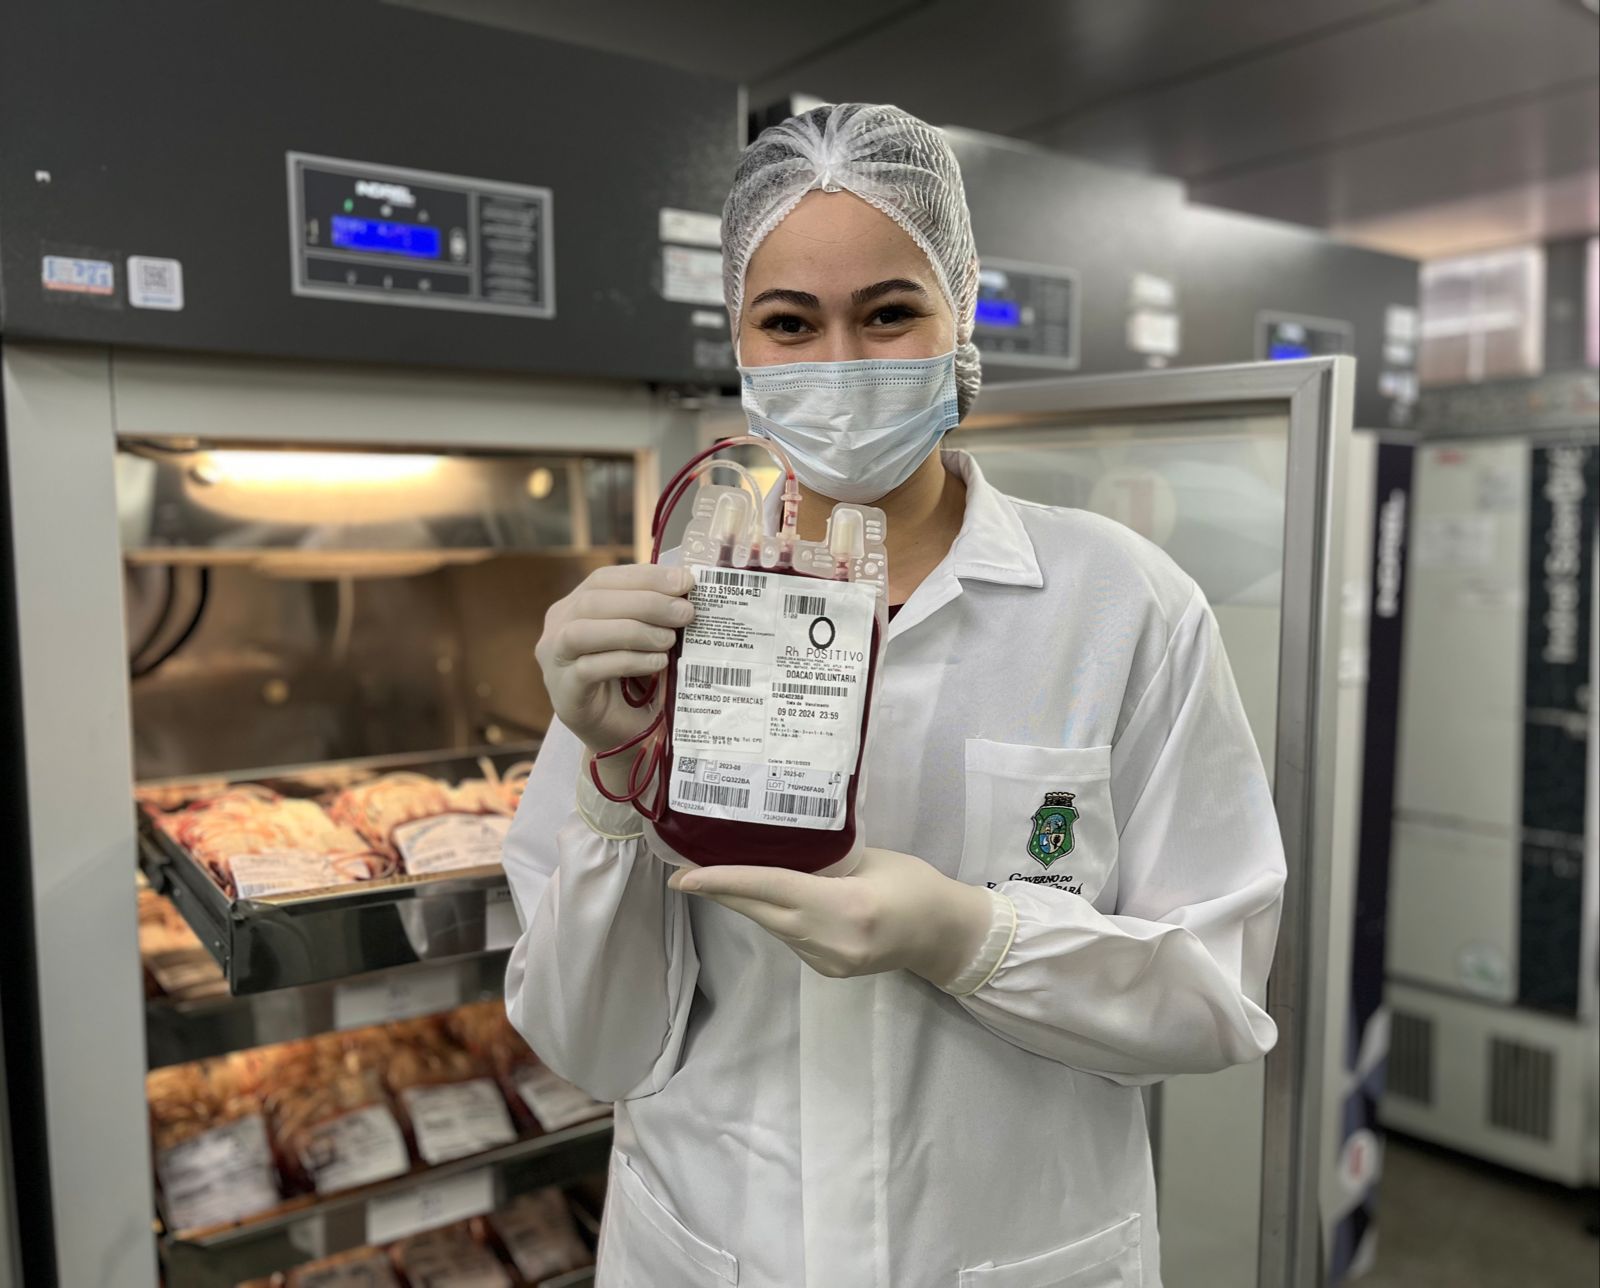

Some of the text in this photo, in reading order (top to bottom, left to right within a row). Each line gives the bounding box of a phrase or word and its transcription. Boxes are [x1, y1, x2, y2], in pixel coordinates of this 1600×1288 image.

[718, 586, 744, 596] 519504
[808, 616, 836, 650] O
[685, 638, 754, 650] DOACAO VOLUNTARIA
[785, 646, 864, 662] Rh POSITIVO
[786, 670, 857, 682] DOACAO VOLUNTARIA
[678, 692, 722, 702] CONCENTRADO
[732, 696, 764, 706] HEMACIAS
[778, 708, 839, 720] 09 02 2024 23:59
